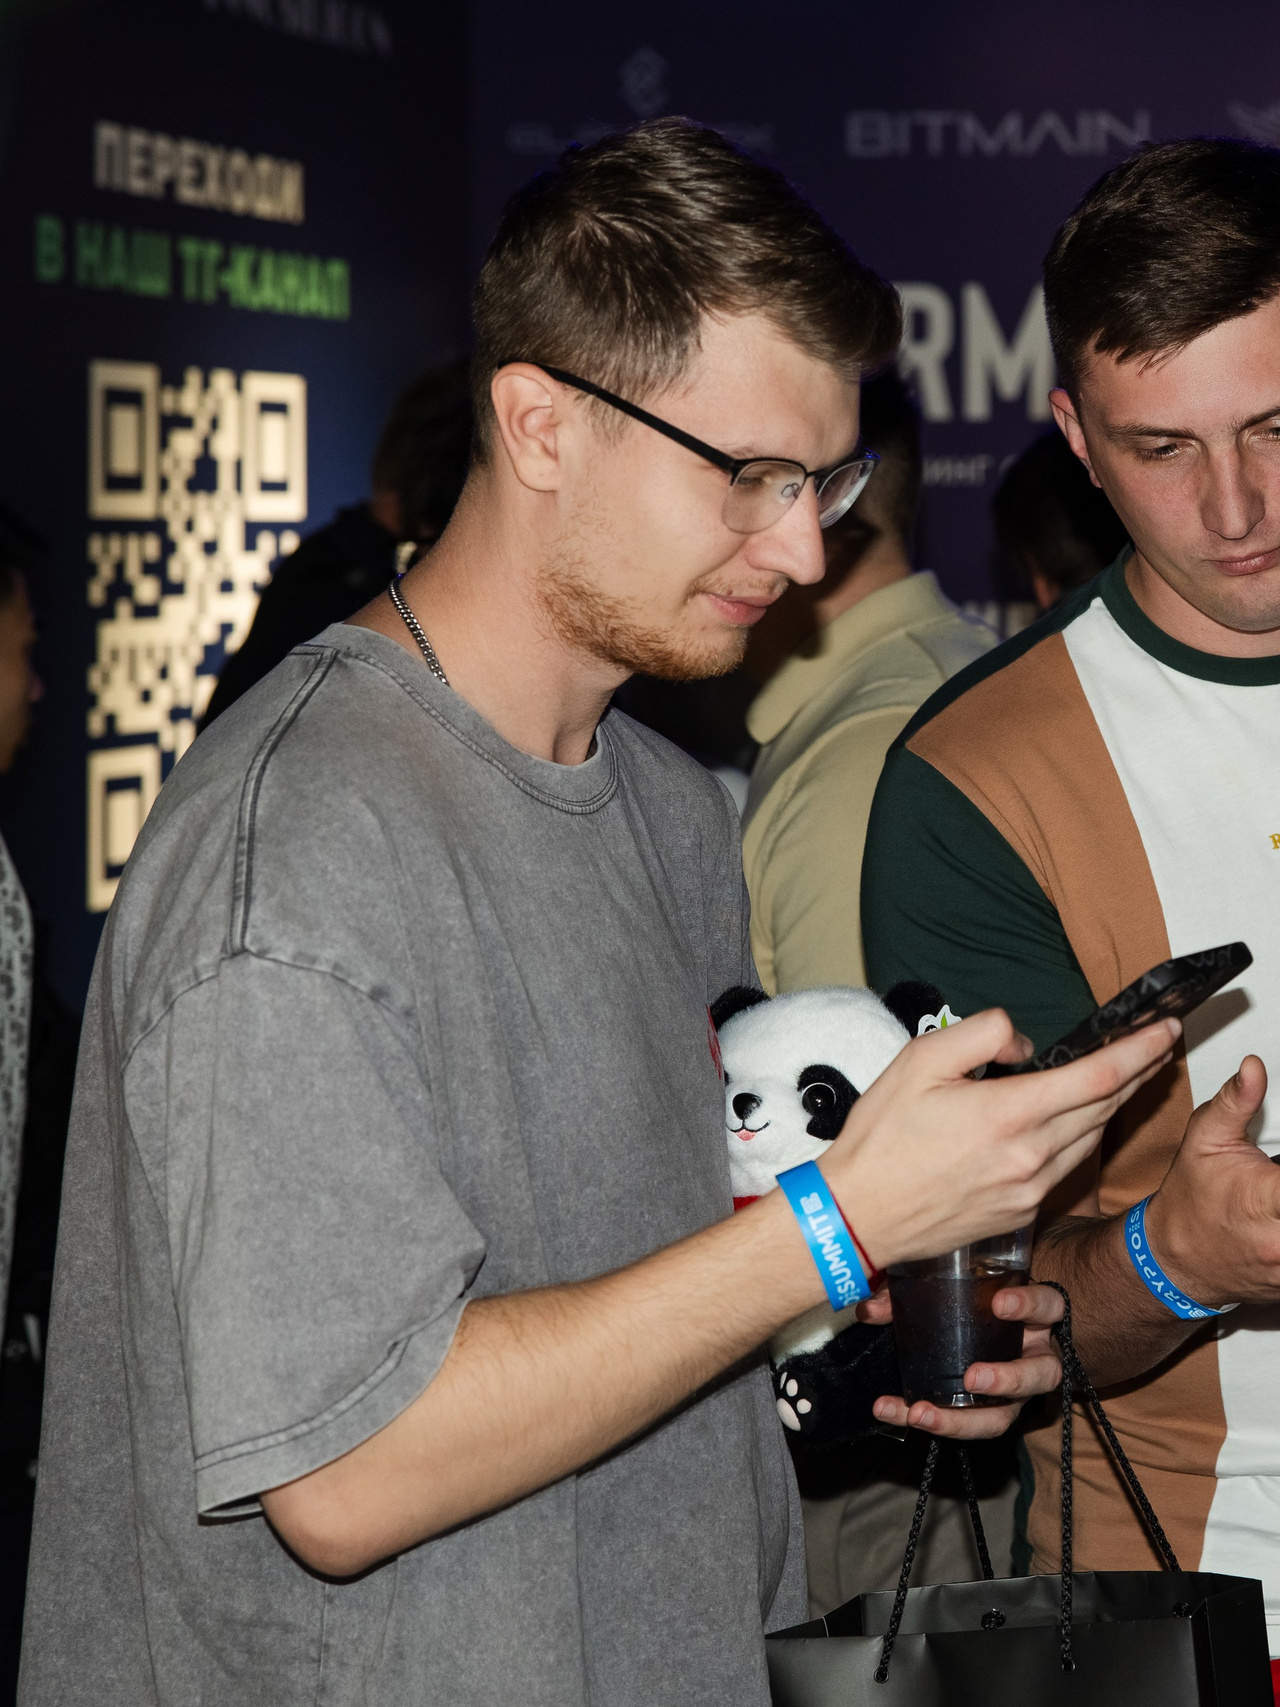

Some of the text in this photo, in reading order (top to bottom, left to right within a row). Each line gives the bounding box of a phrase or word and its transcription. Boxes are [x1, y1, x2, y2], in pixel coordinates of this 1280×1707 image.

[95, 120, 304, 224] ПЕРЕХОДИ
[846, 110, 1150, 156] BITMAIN
[36, 214, 349, 321] В НАШ ТГ-КАНАЛ
[808, 1213, 856, 1294] SUMMIT
[1131, 1232, 1192, 1310] CRYPTO
